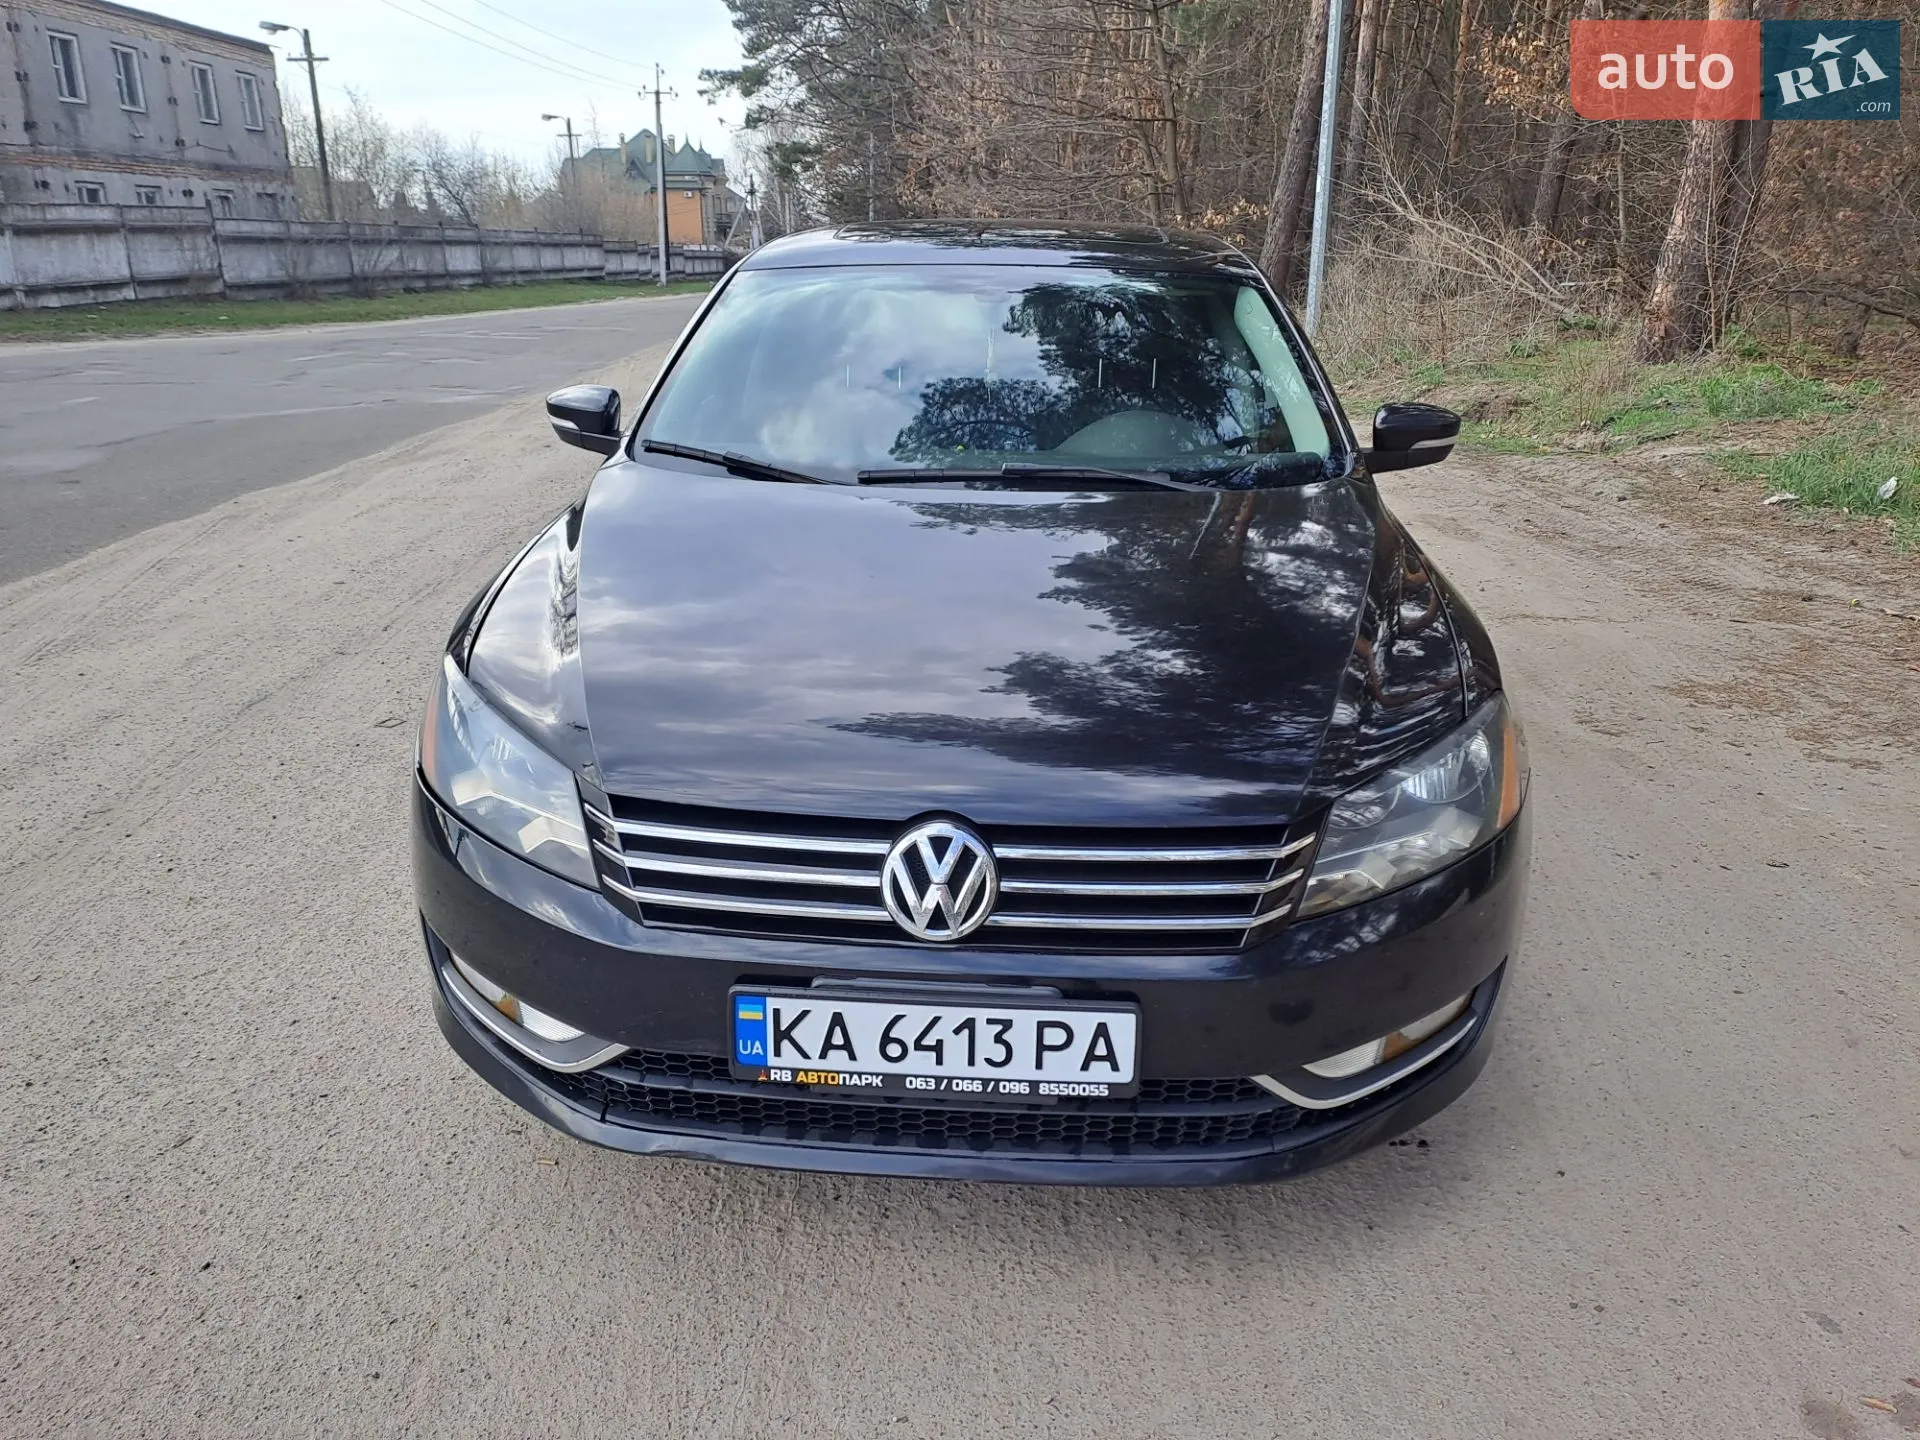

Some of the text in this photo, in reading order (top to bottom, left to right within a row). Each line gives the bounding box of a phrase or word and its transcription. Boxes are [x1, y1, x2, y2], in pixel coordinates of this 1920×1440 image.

[739, 1041, 764, 1056] UA
[772, 1007, 1121, 1073] KA 6413 PA
[770, 1069, 792, 1082] RB
[796, 1071, 884, 1088] АВТОПАРК
[905, 1077, 936, 1091] 063
[951, 1079, 983, 1092] 066
[999, 1081, 1030, 1095] 096
[1038, 1083, 1110, 1097] 8550055
